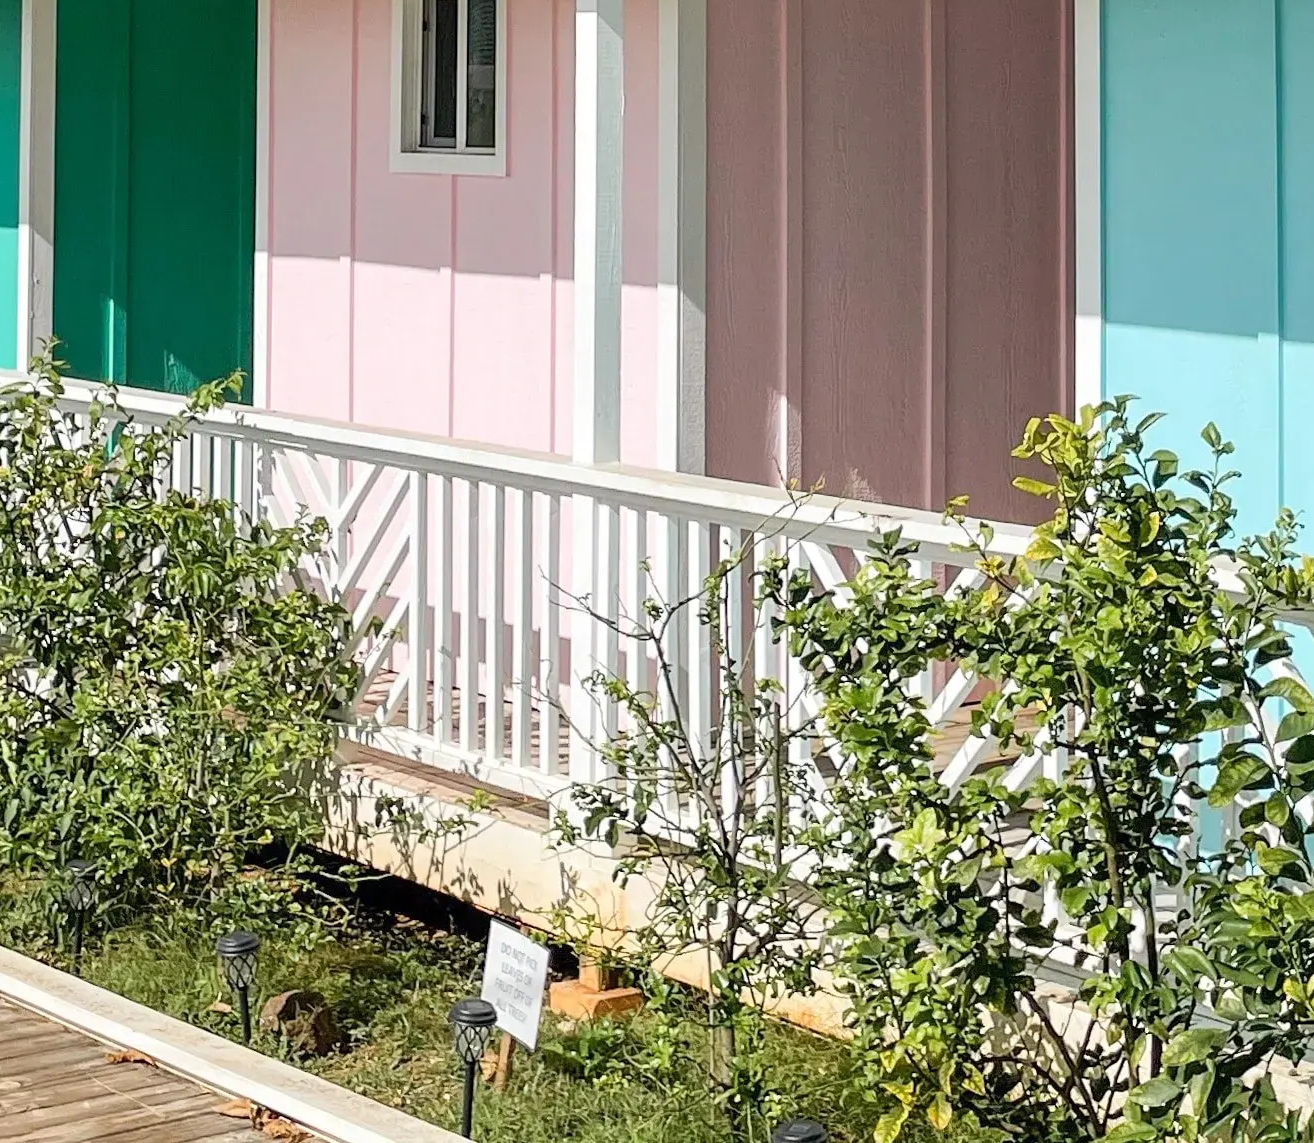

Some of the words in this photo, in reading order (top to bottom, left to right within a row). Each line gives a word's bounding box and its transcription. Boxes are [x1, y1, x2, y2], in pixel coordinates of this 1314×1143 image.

[501, 942, 512, 956] DO
[512, 948, 525, 962] NOT
[501, 961, 524, 983] LEAVES
[494, 977, 514, 994] FRUIT
